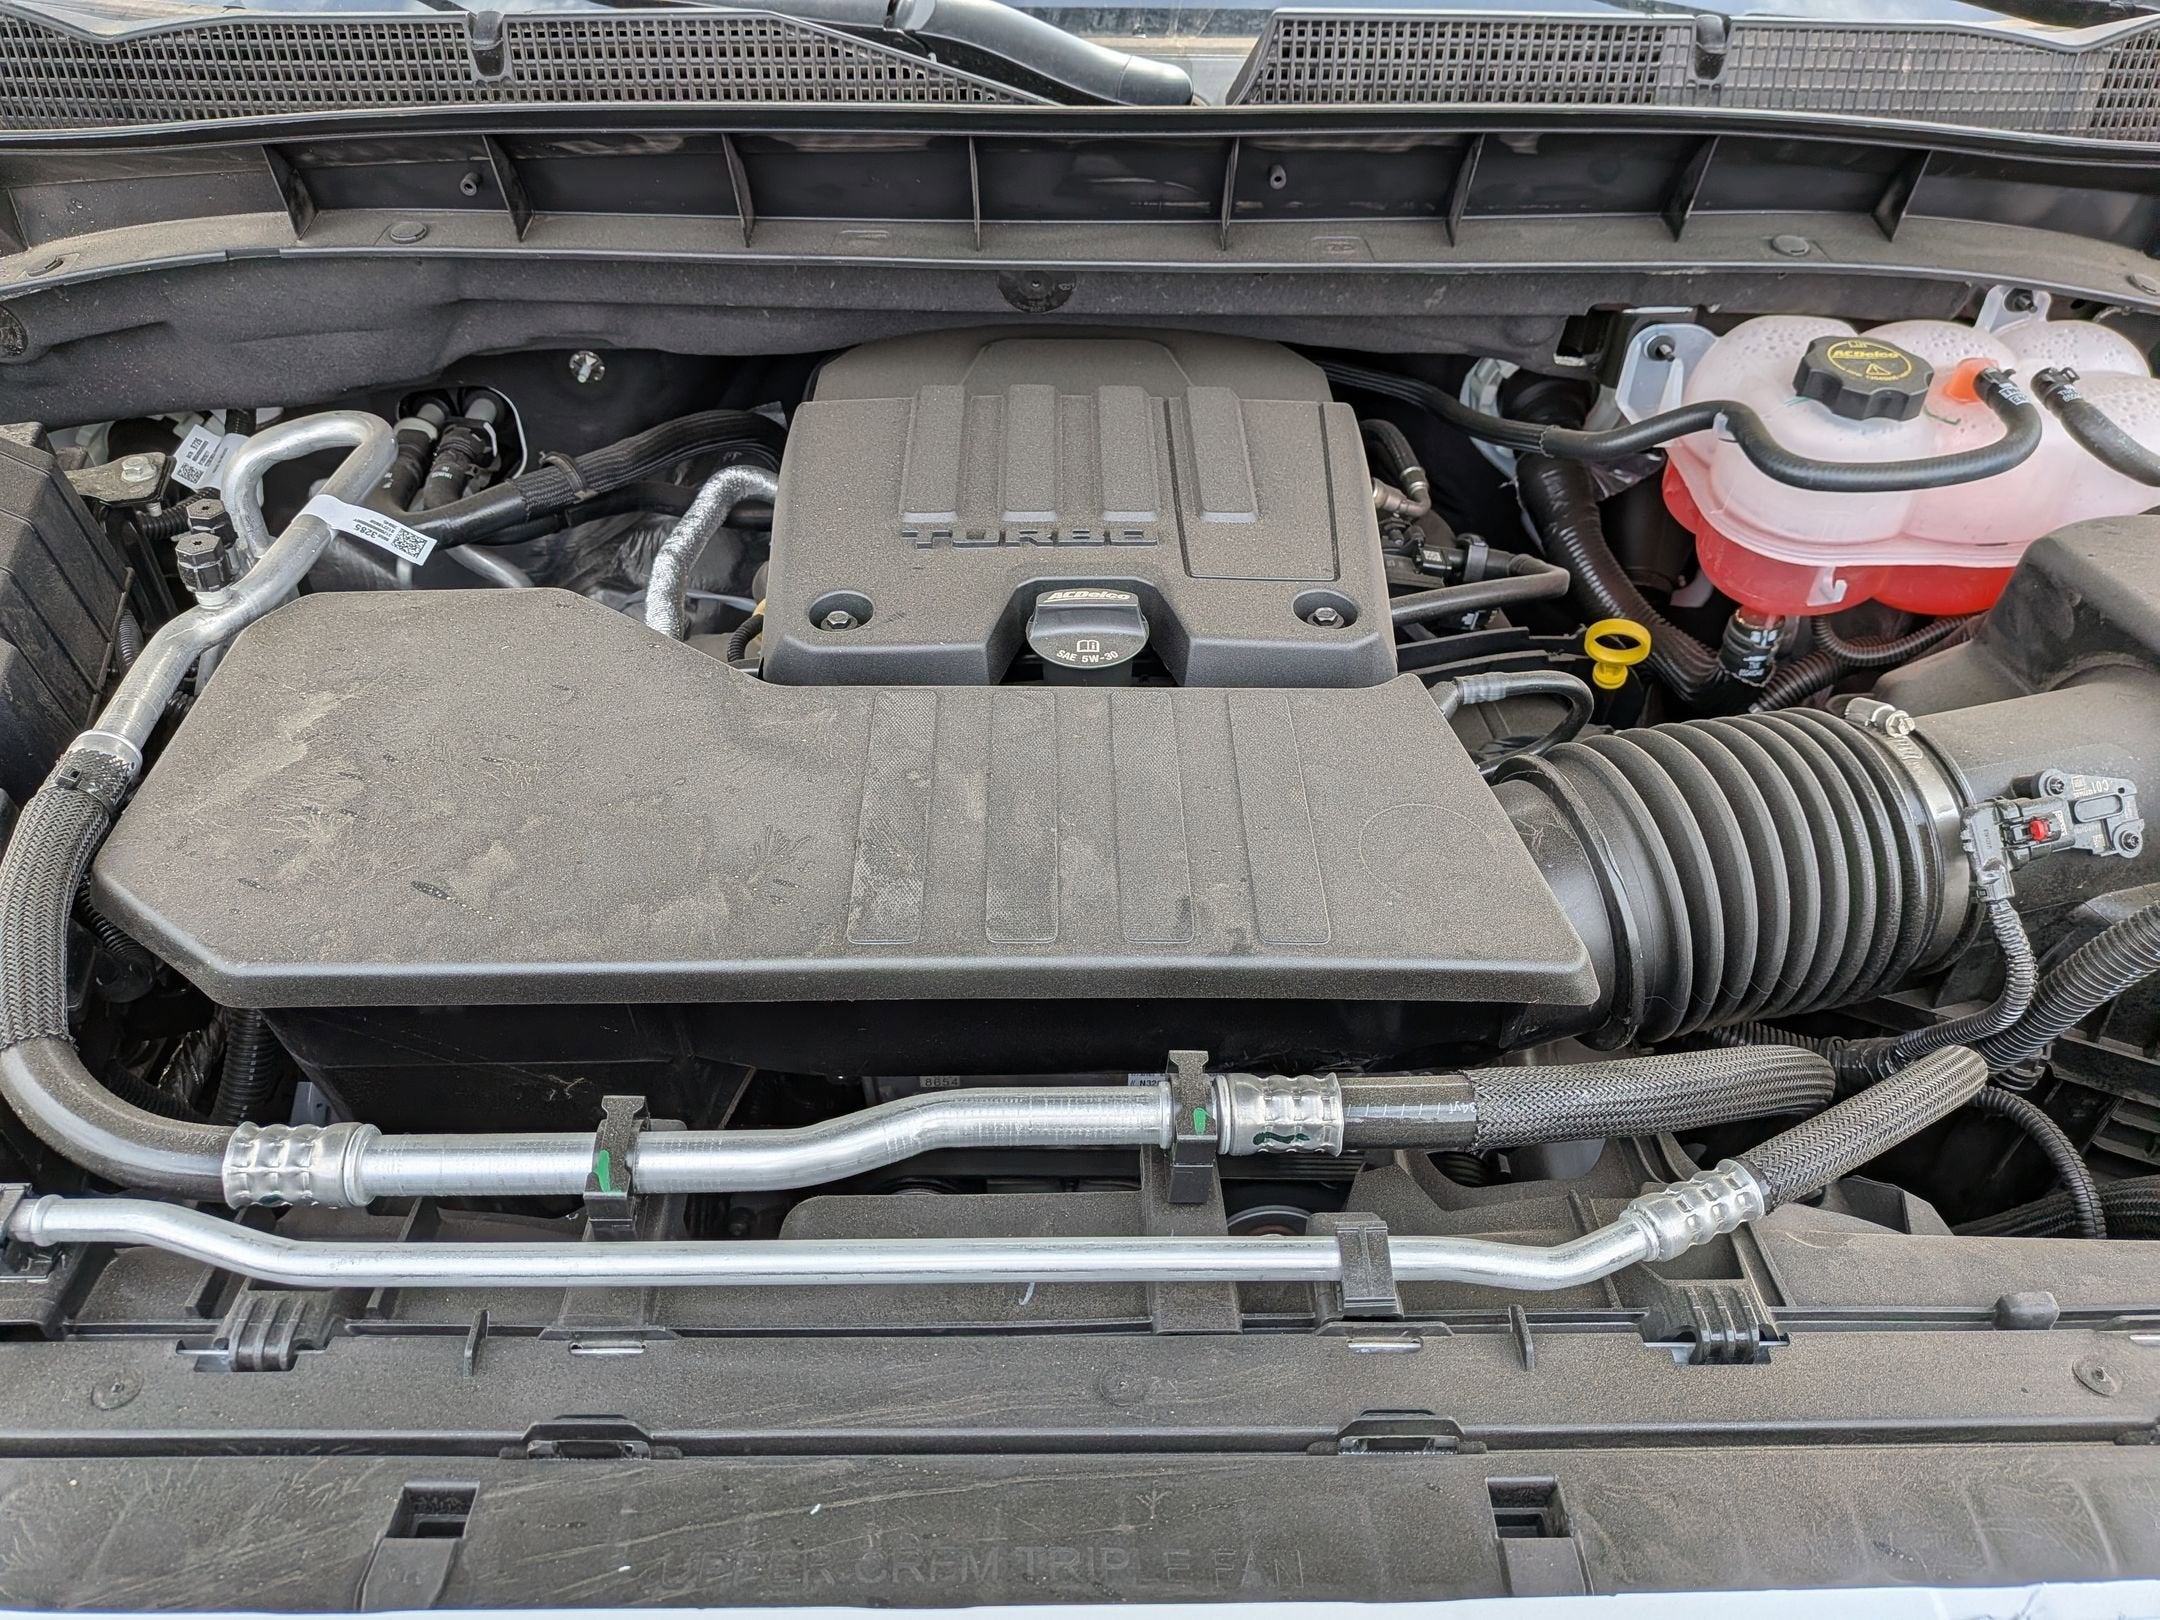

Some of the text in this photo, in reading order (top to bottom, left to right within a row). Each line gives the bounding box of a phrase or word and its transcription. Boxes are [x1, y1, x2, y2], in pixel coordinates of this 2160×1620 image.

[354, 524, 378, 539] 3285
[901, 529, 1158, 549] TURBO
[1046, 591, 1131, 602] ACDelco
[1056, 649, 1119, 663] SAE 5W-30
[925, 1078, 958, 1087] 8654
[661, 1549, 837, 1589] UPPER
